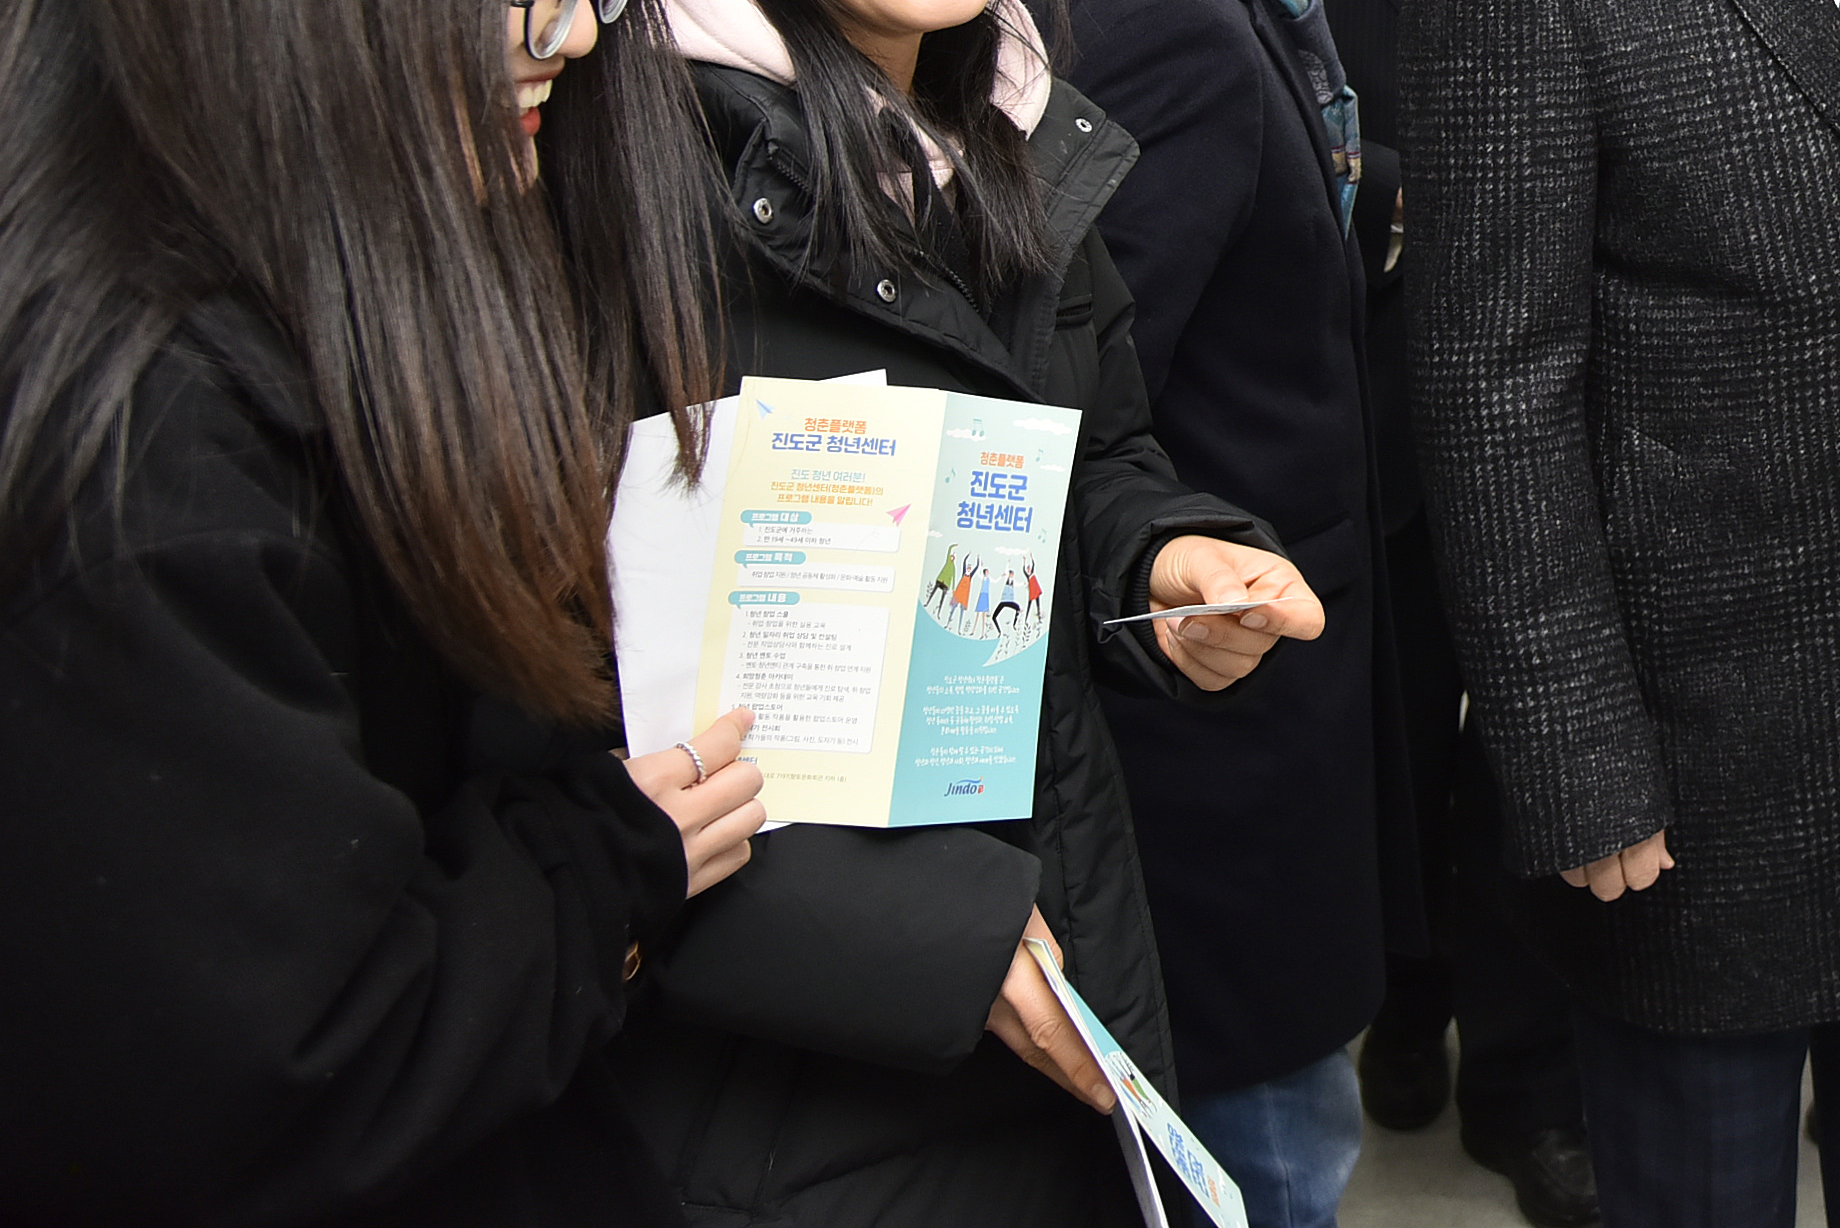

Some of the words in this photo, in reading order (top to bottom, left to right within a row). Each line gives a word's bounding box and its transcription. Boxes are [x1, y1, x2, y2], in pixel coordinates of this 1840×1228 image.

[804, 417, 867, 435] 청춘플랫폼
[771, 432, 823, 452] 진도군
[826, 435, 897, 457] 청년센터
[980, 451, 1025, 469] 청춘플랫폼
[791, 469, 810, 481] 진도
[812, 470, 831, 482] 청년
[833, 471, 866, 483] 여러분!
[770, 481, 795, 492] 진도군
[970, 470, 1028, 501] 진도군
[776, 493, 809, 503] 프로그램
[957, 500, 1033, 533] 청년센터
[943, 781, 978, 797] Jindo
